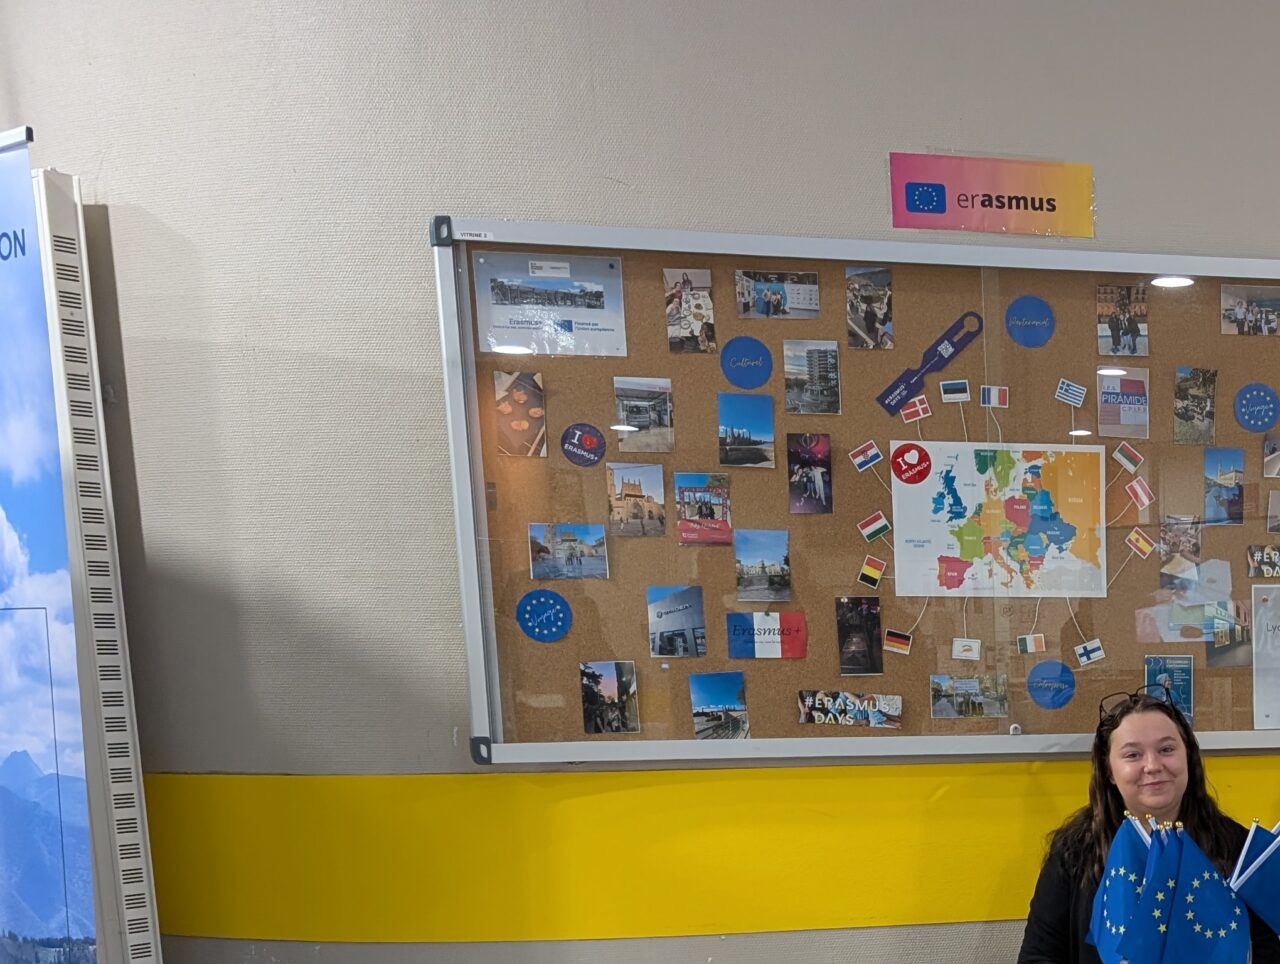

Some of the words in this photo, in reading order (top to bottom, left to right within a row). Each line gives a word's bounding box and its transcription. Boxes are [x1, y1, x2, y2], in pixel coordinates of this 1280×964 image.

[956, 193, 1057, 213] erasmus
[571, 430, 582, 444] I
[564, 443, 598, 461] ERASMUS+
[896, 457, 908, 471] I
[815, 713, 855, 726] DAYS
